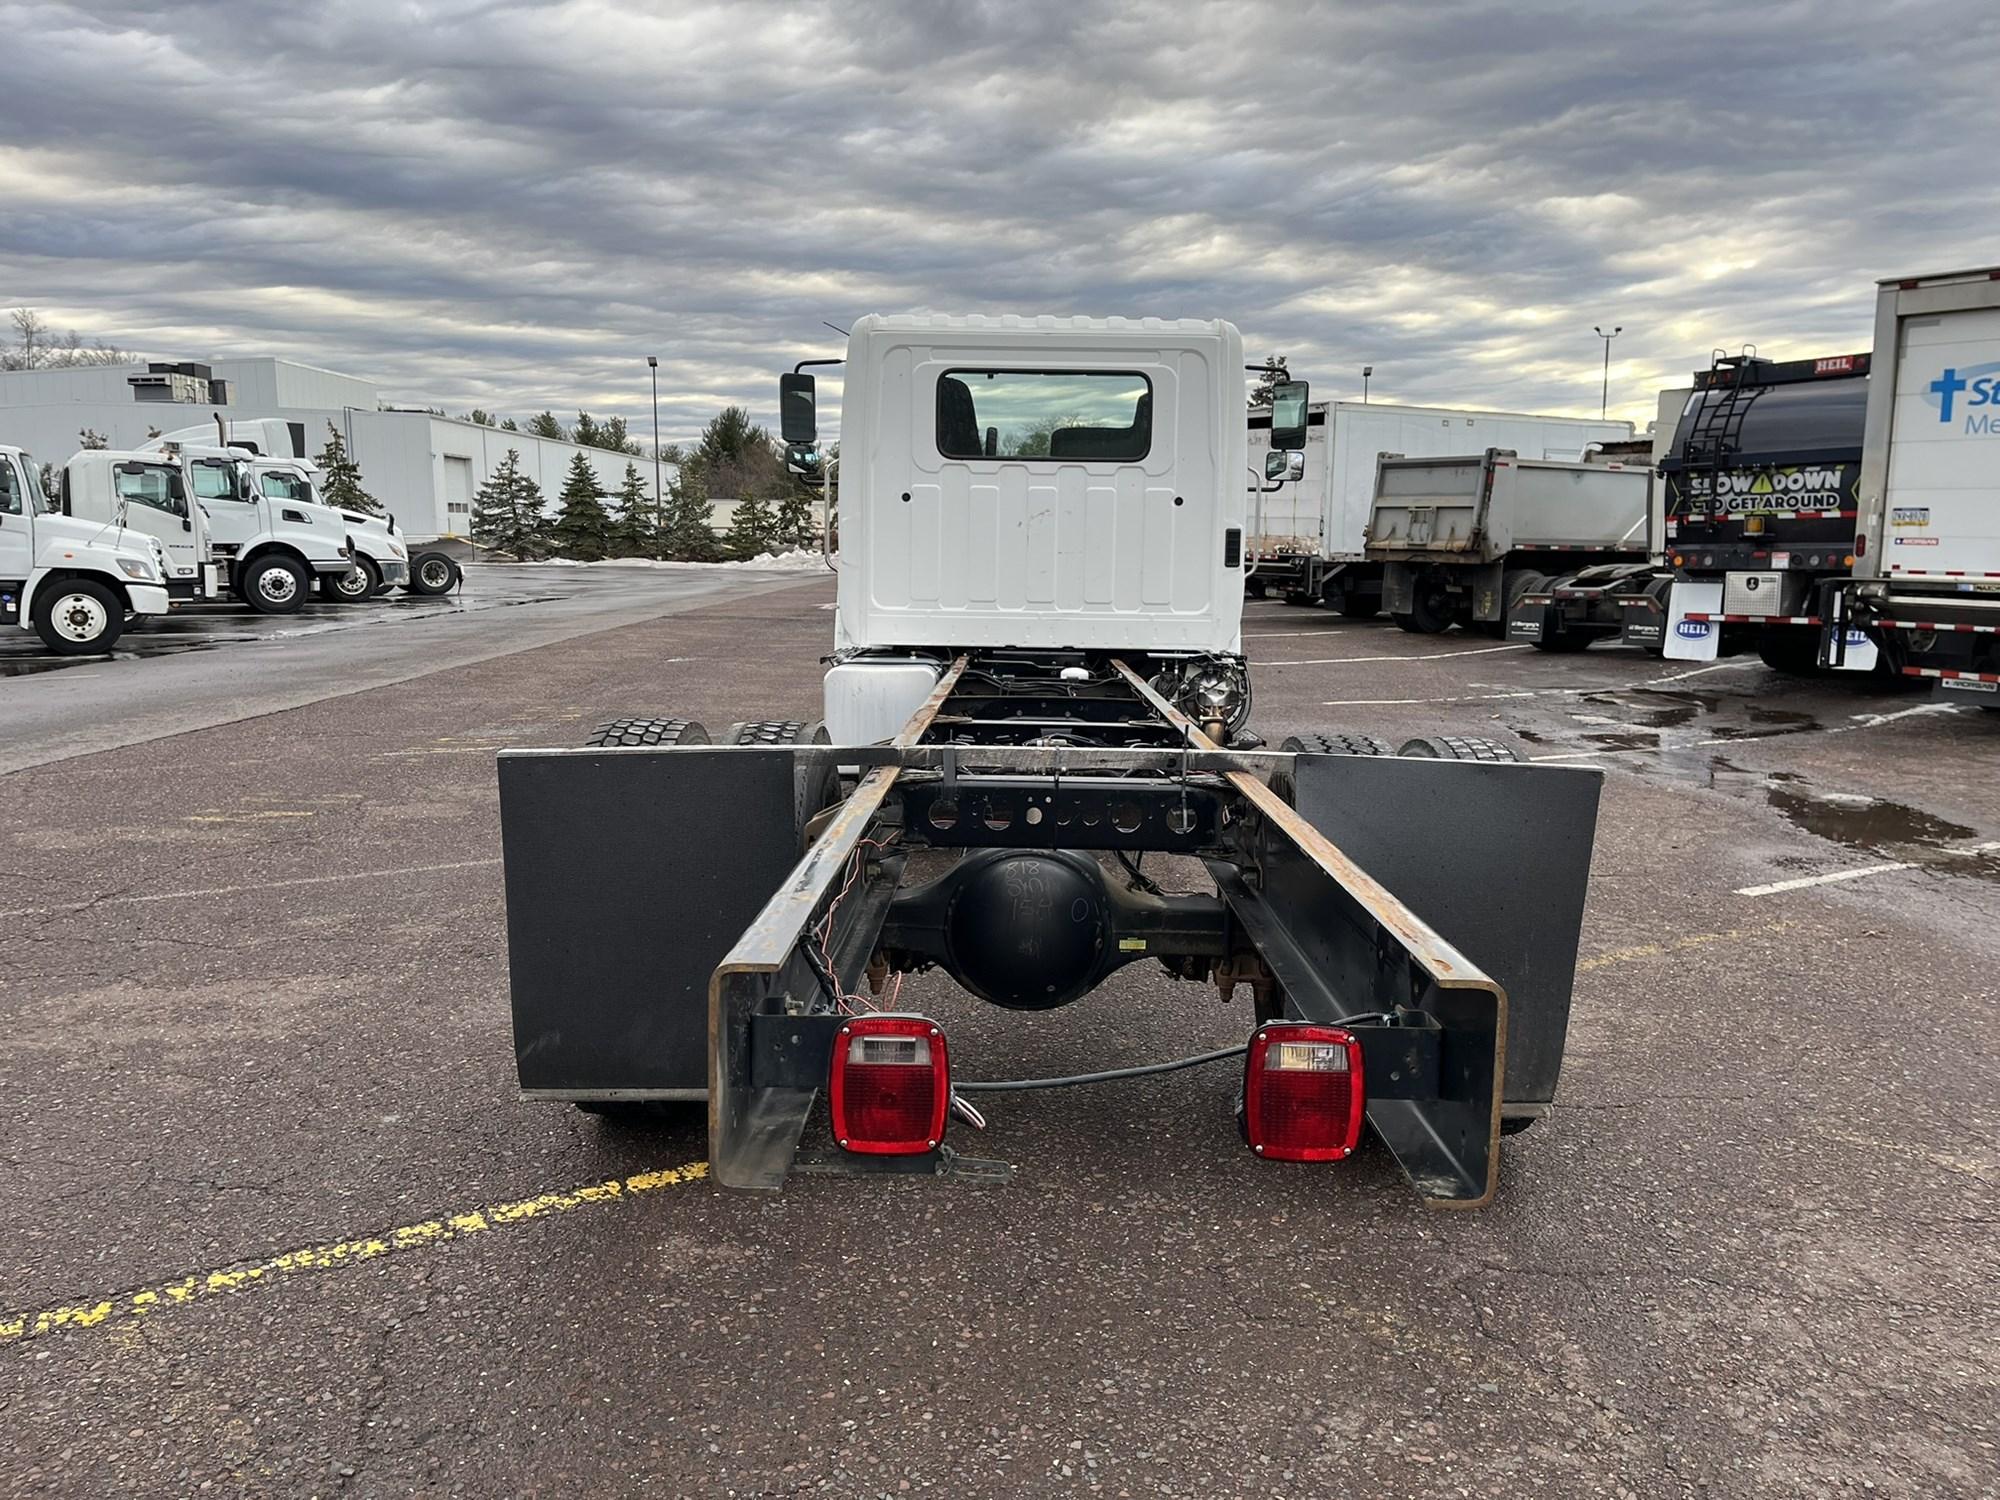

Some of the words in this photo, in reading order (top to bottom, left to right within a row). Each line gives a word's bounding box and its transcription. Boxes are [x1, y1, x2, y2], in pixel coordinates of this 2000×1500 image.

[1817, 358, 1849, 371] HEIL
[1773, 470, 1841, 490] DOWN
[1729, 497, 1758, 510] GET
[1763, 494, 1838, 509] AROUND
[1679, 623, 1708, 634] HEIL
